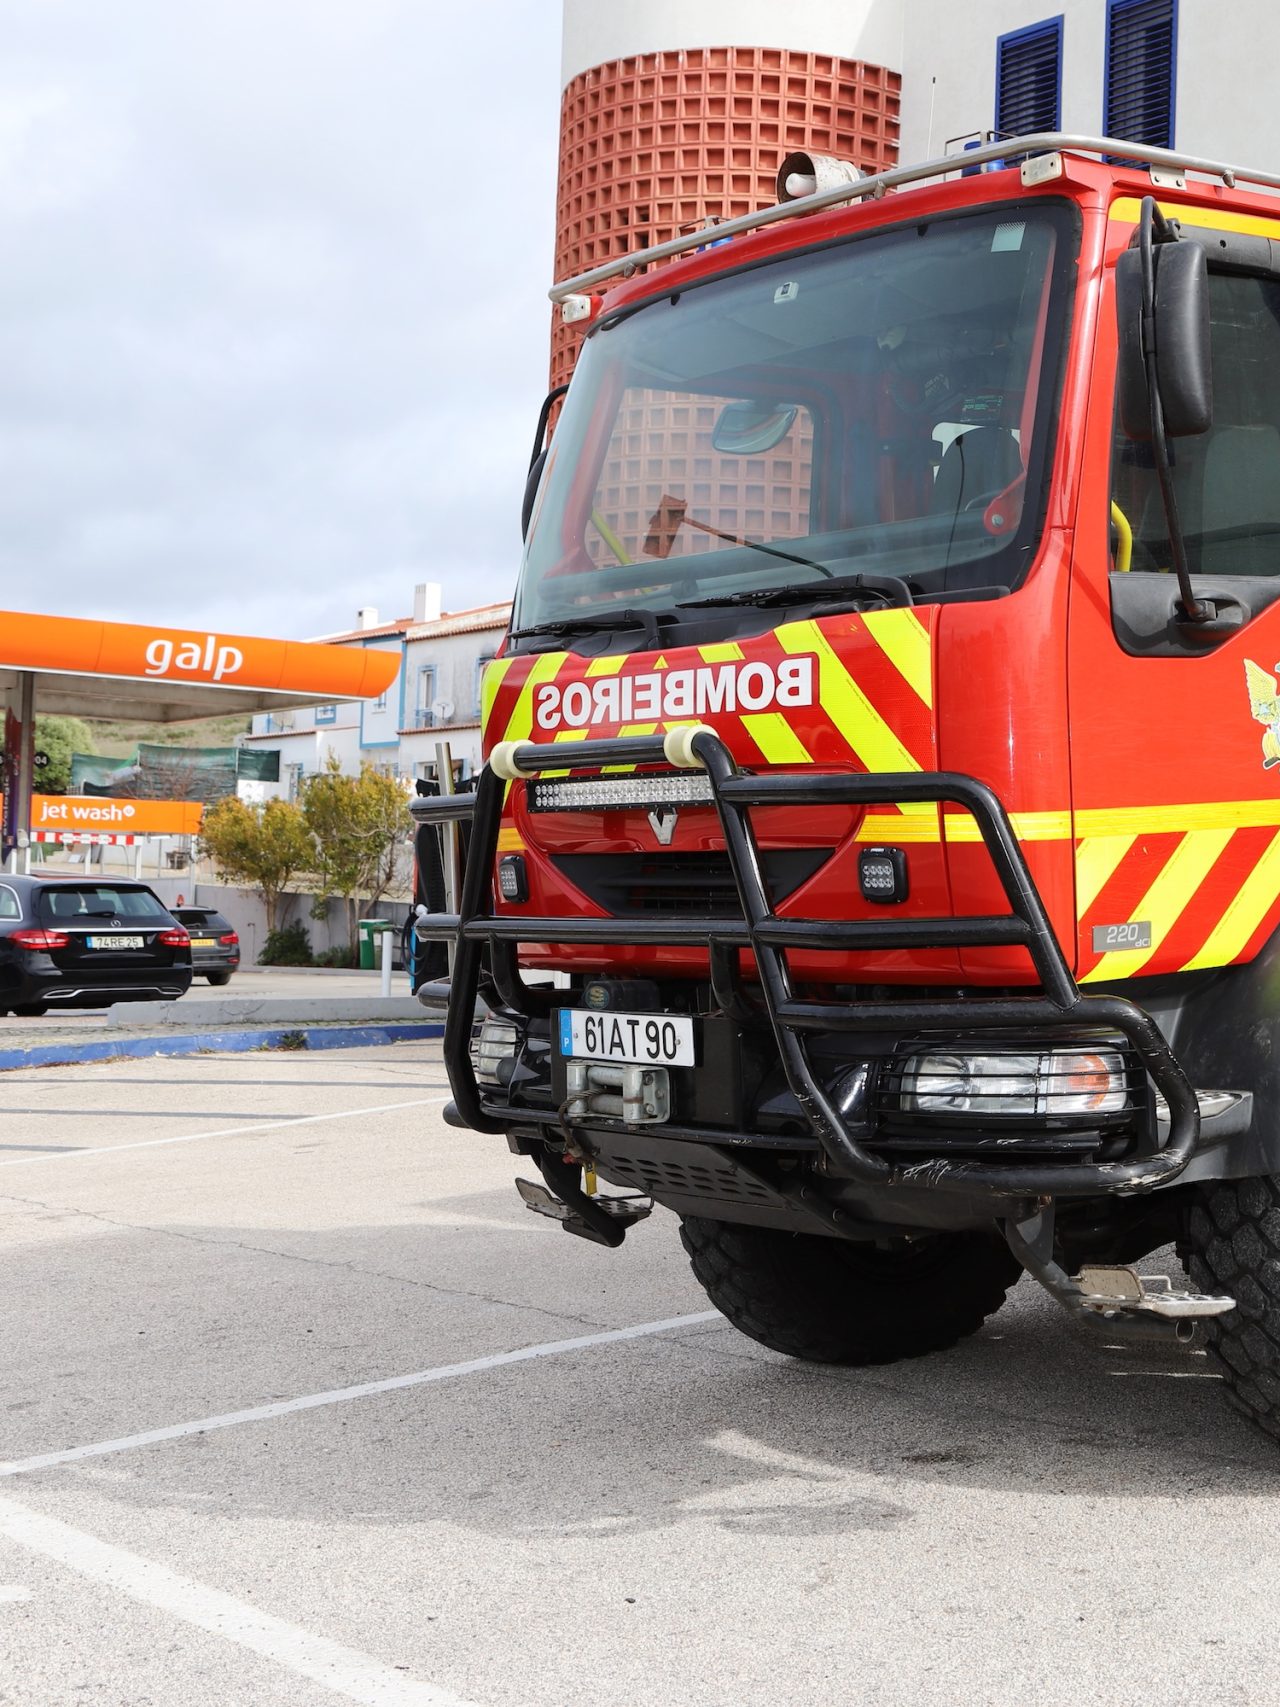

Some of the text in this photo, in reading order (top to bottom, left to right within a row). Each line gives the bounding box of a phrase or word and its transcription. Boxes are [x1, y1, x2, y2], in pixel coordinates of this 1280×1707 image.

[145, 636, 243, 680] galp
[35, 756, 47, 765] 04
[41, 802, 122, 821] jet wash
[1107, 924, 1138, 943] 220
[564, 1037, 569, 1047] P
